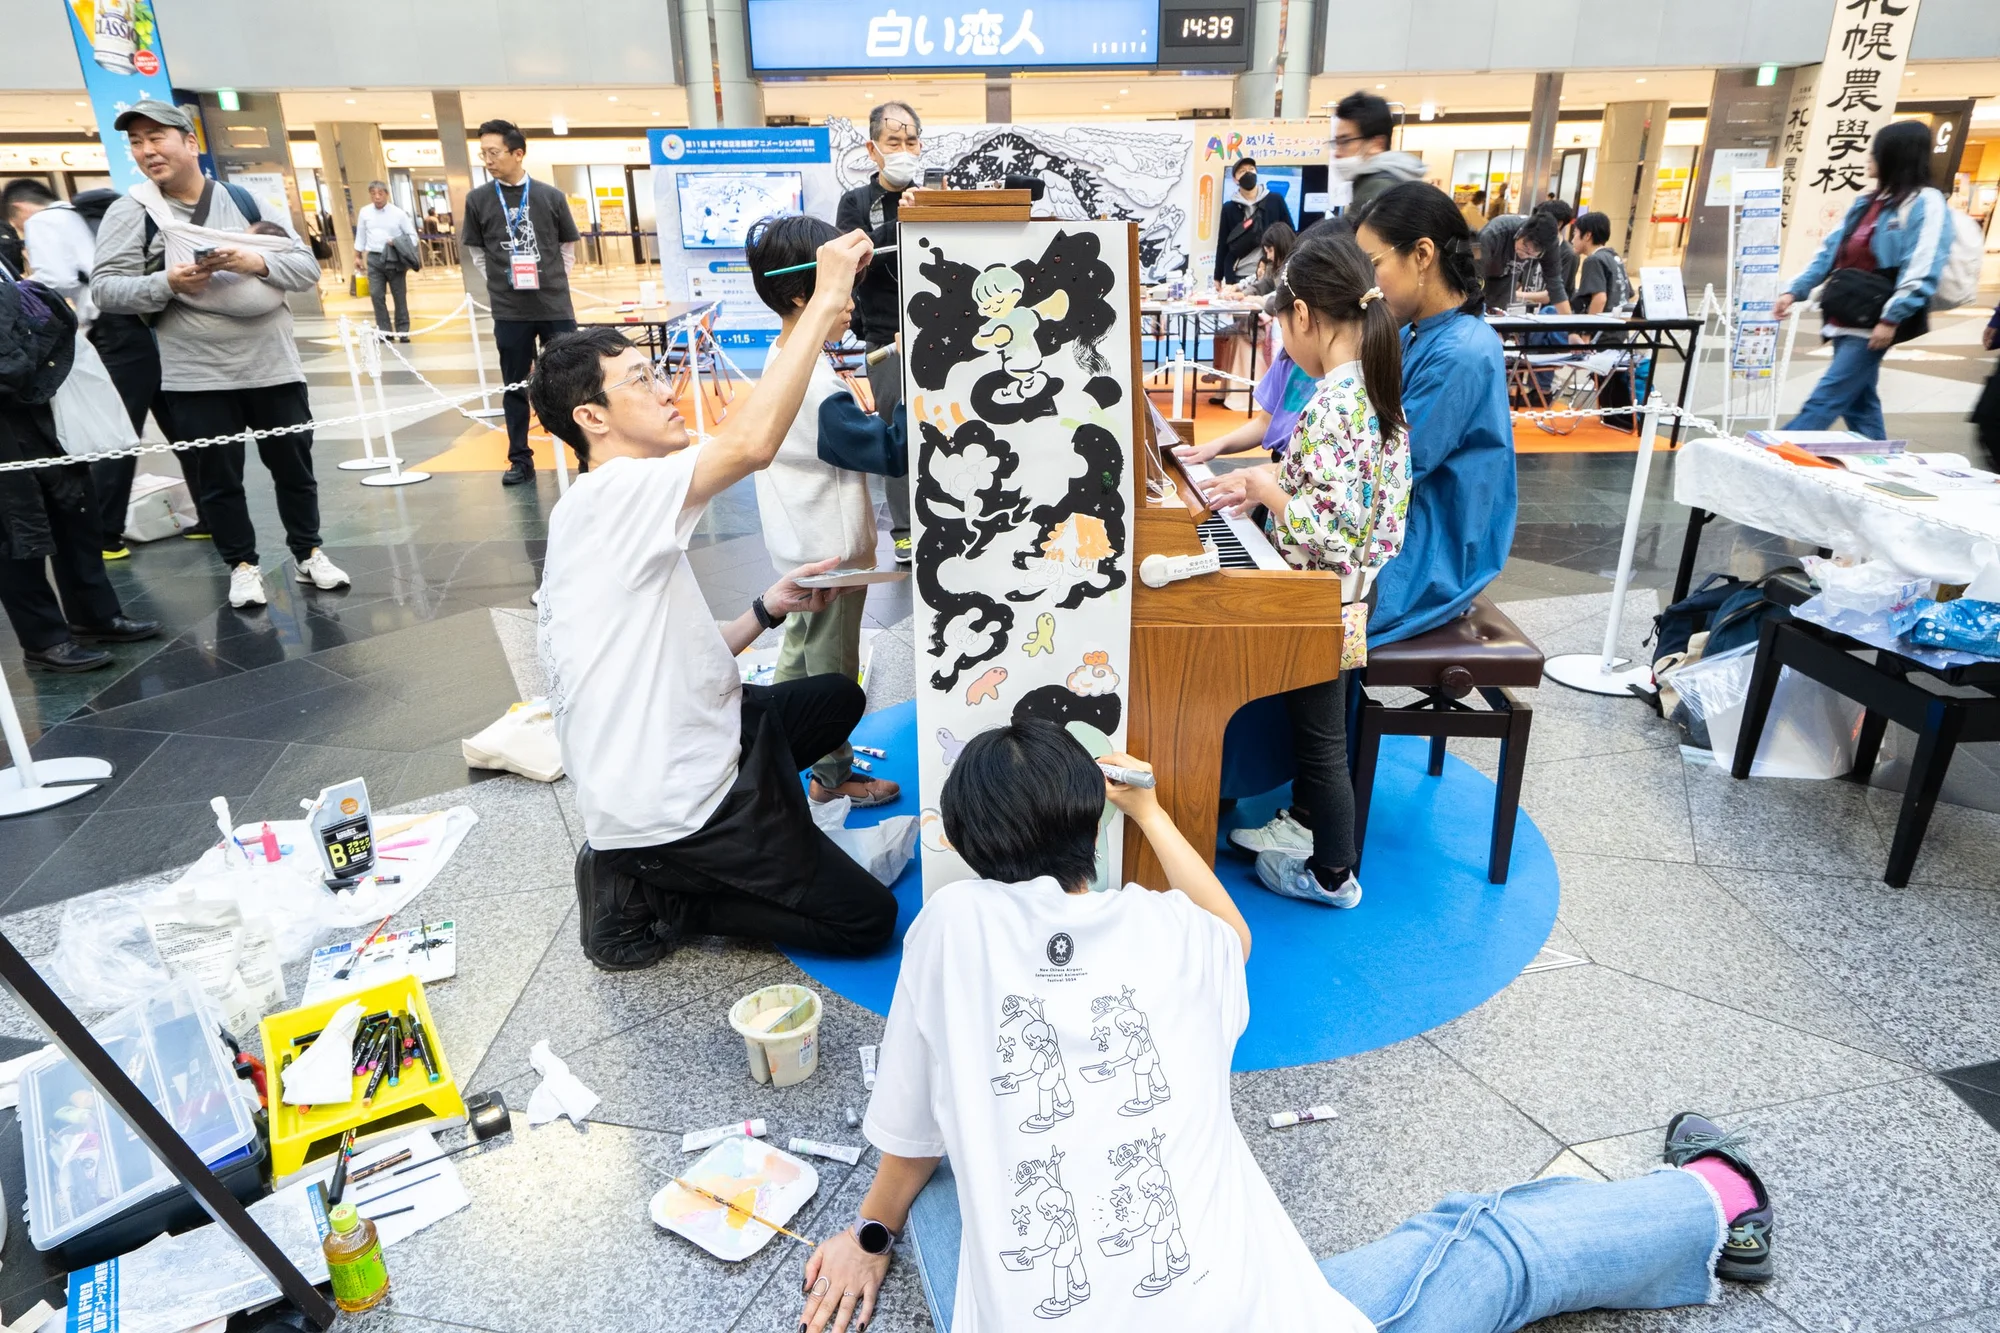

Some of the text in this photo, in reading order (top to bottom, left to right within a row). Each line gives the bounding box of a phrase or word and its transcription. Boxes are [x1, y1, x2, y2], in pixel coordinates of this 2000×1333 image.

[866, 9, 1044, 56] 白い恋人
[1182, 16, 1234, 39] 14:39
[1936, 121, 1953, 146] C
[1205, 132, 1243, 161] AR
[328, 843, 347, 868] B
